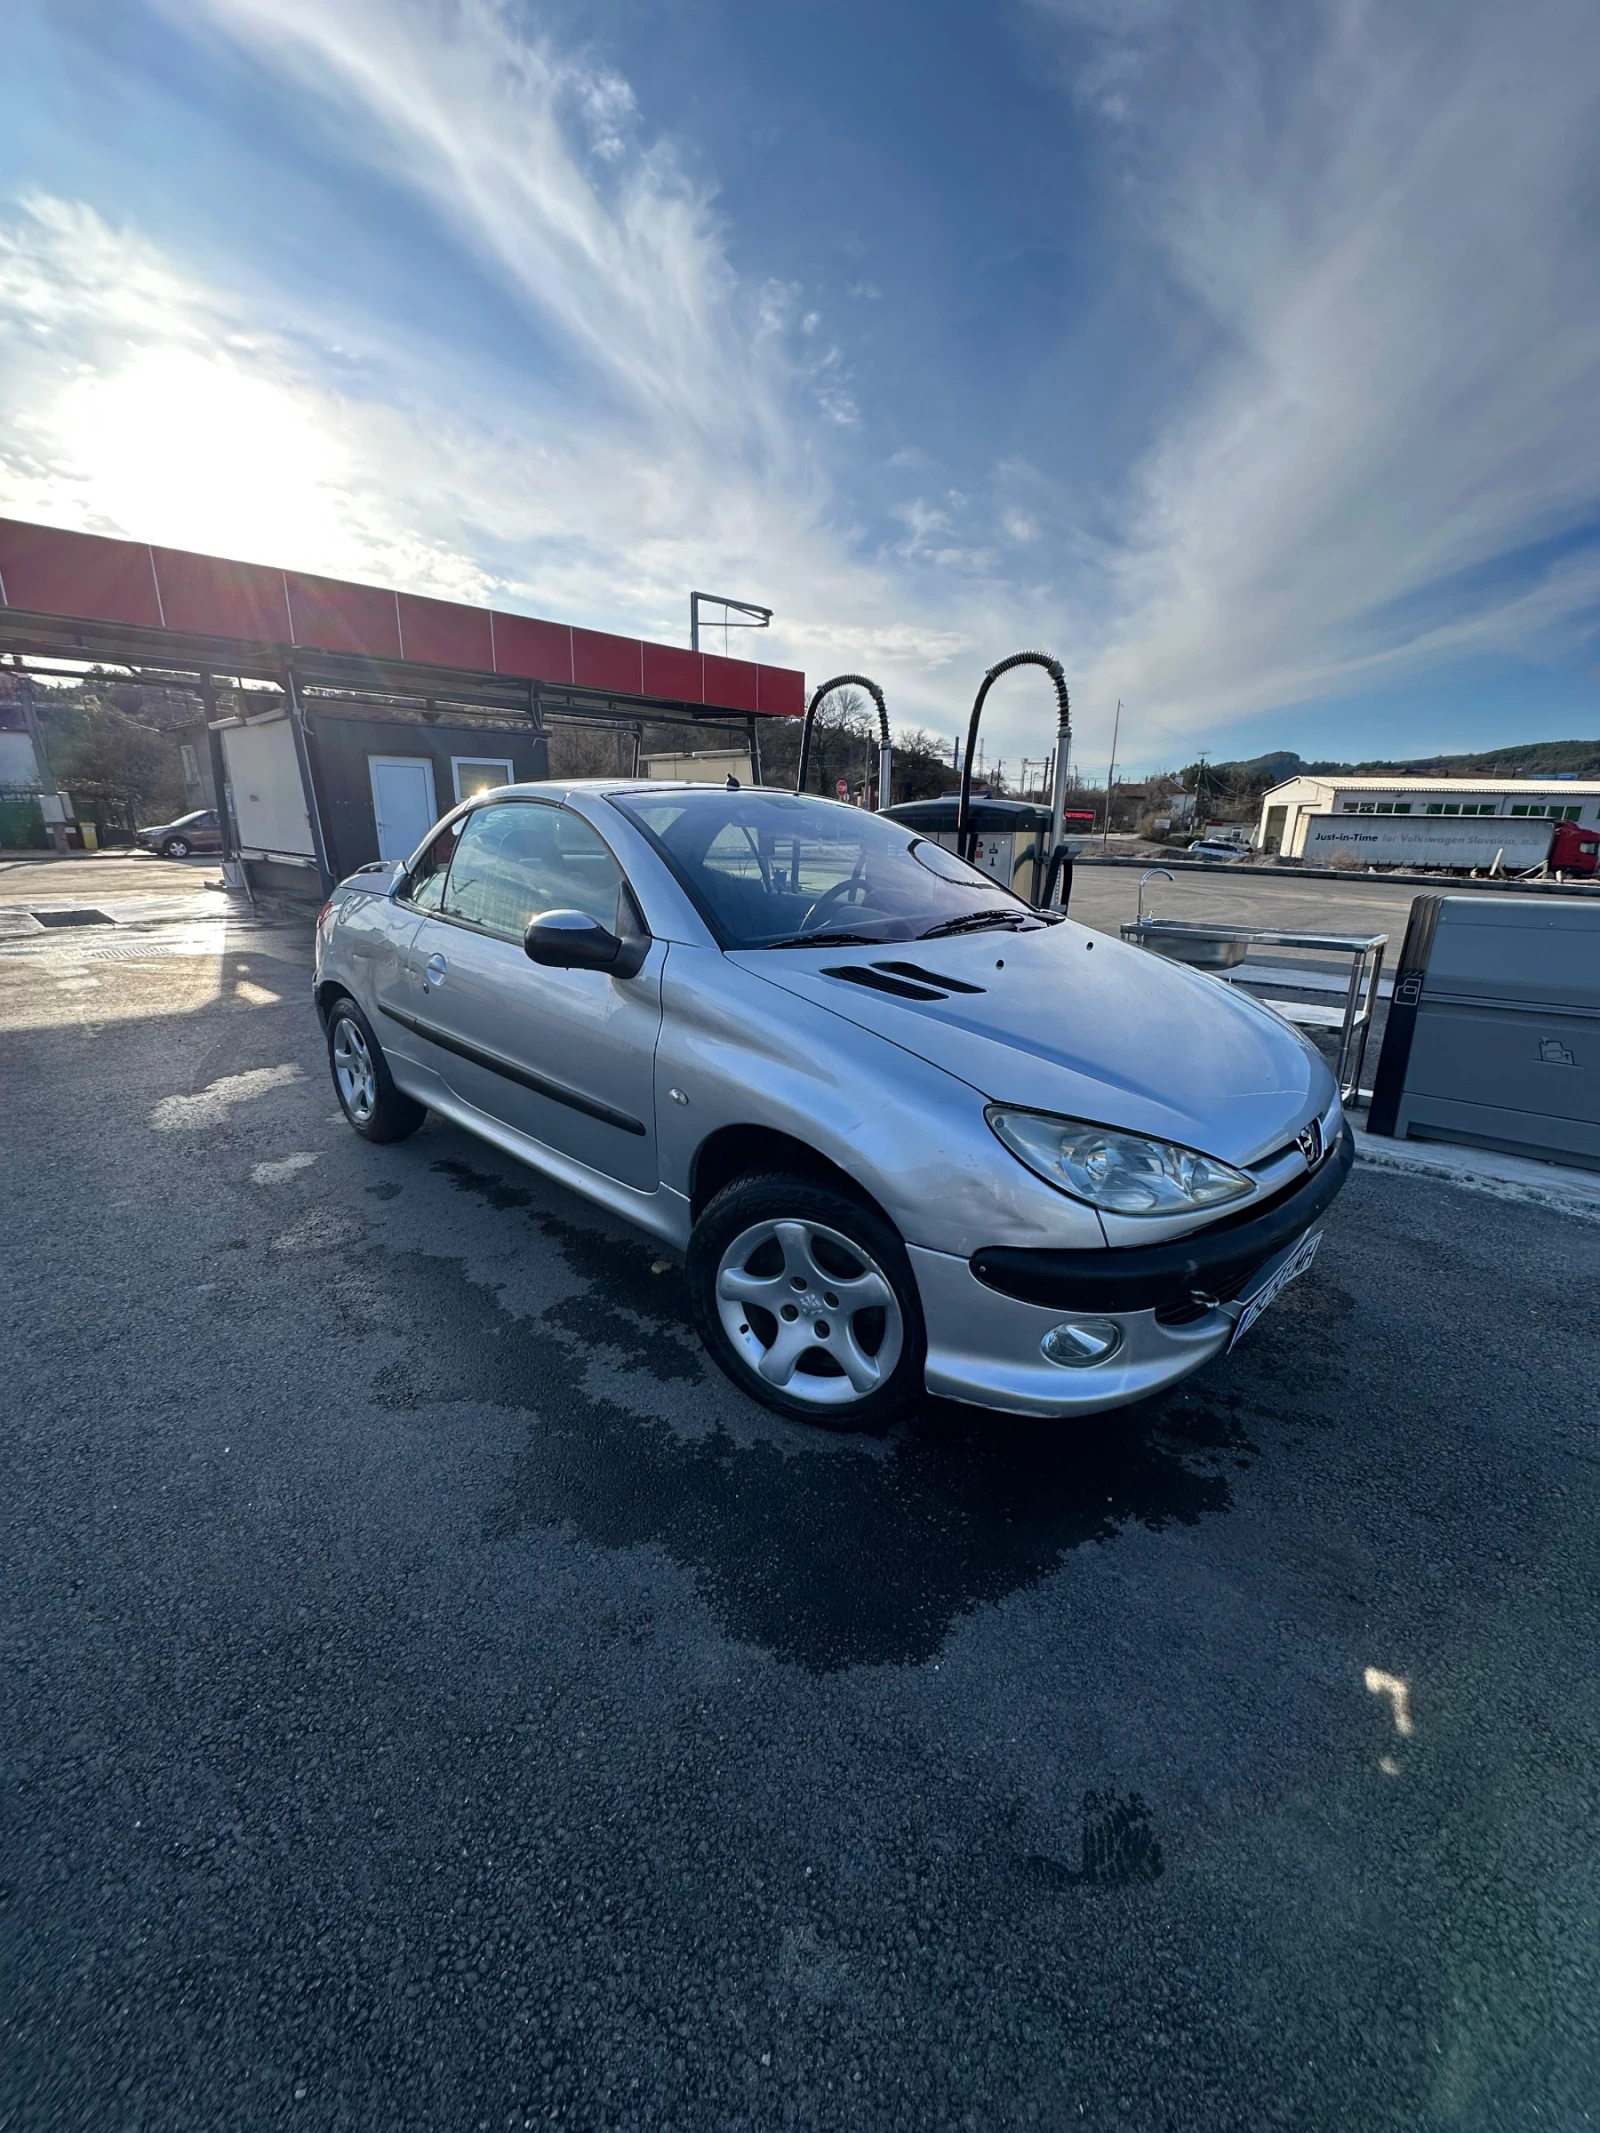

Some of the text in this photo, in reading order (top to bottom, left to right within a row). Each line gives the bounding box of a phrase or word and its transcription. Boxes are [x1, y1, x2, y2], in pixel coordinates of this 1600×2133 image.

[1315, 833, 1378, 842] Just-in-Time
[1382, 834, 1397, 843] for
[1401, 834, 1465, 846] Volkswagen
